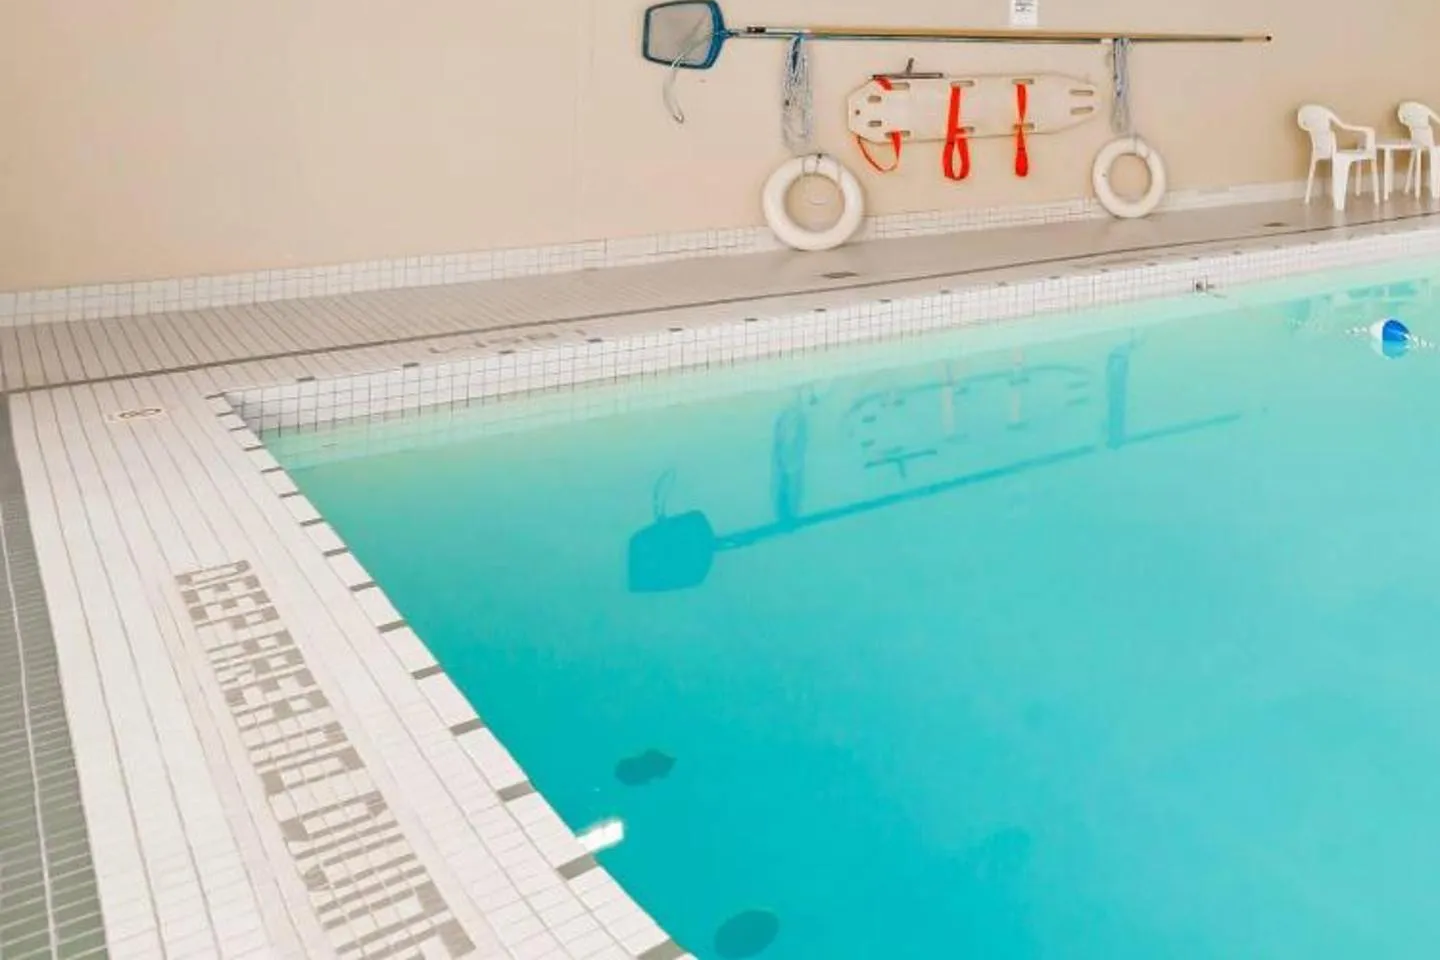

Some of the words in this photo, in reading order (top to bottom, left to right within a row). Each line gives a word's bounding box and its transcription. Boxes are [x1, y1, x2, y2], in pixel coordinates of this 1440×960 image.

[175, 560, 279, 628] DEEP
[206, 630, 330, 731] AREA
[248, 720, 366, 795] NO
